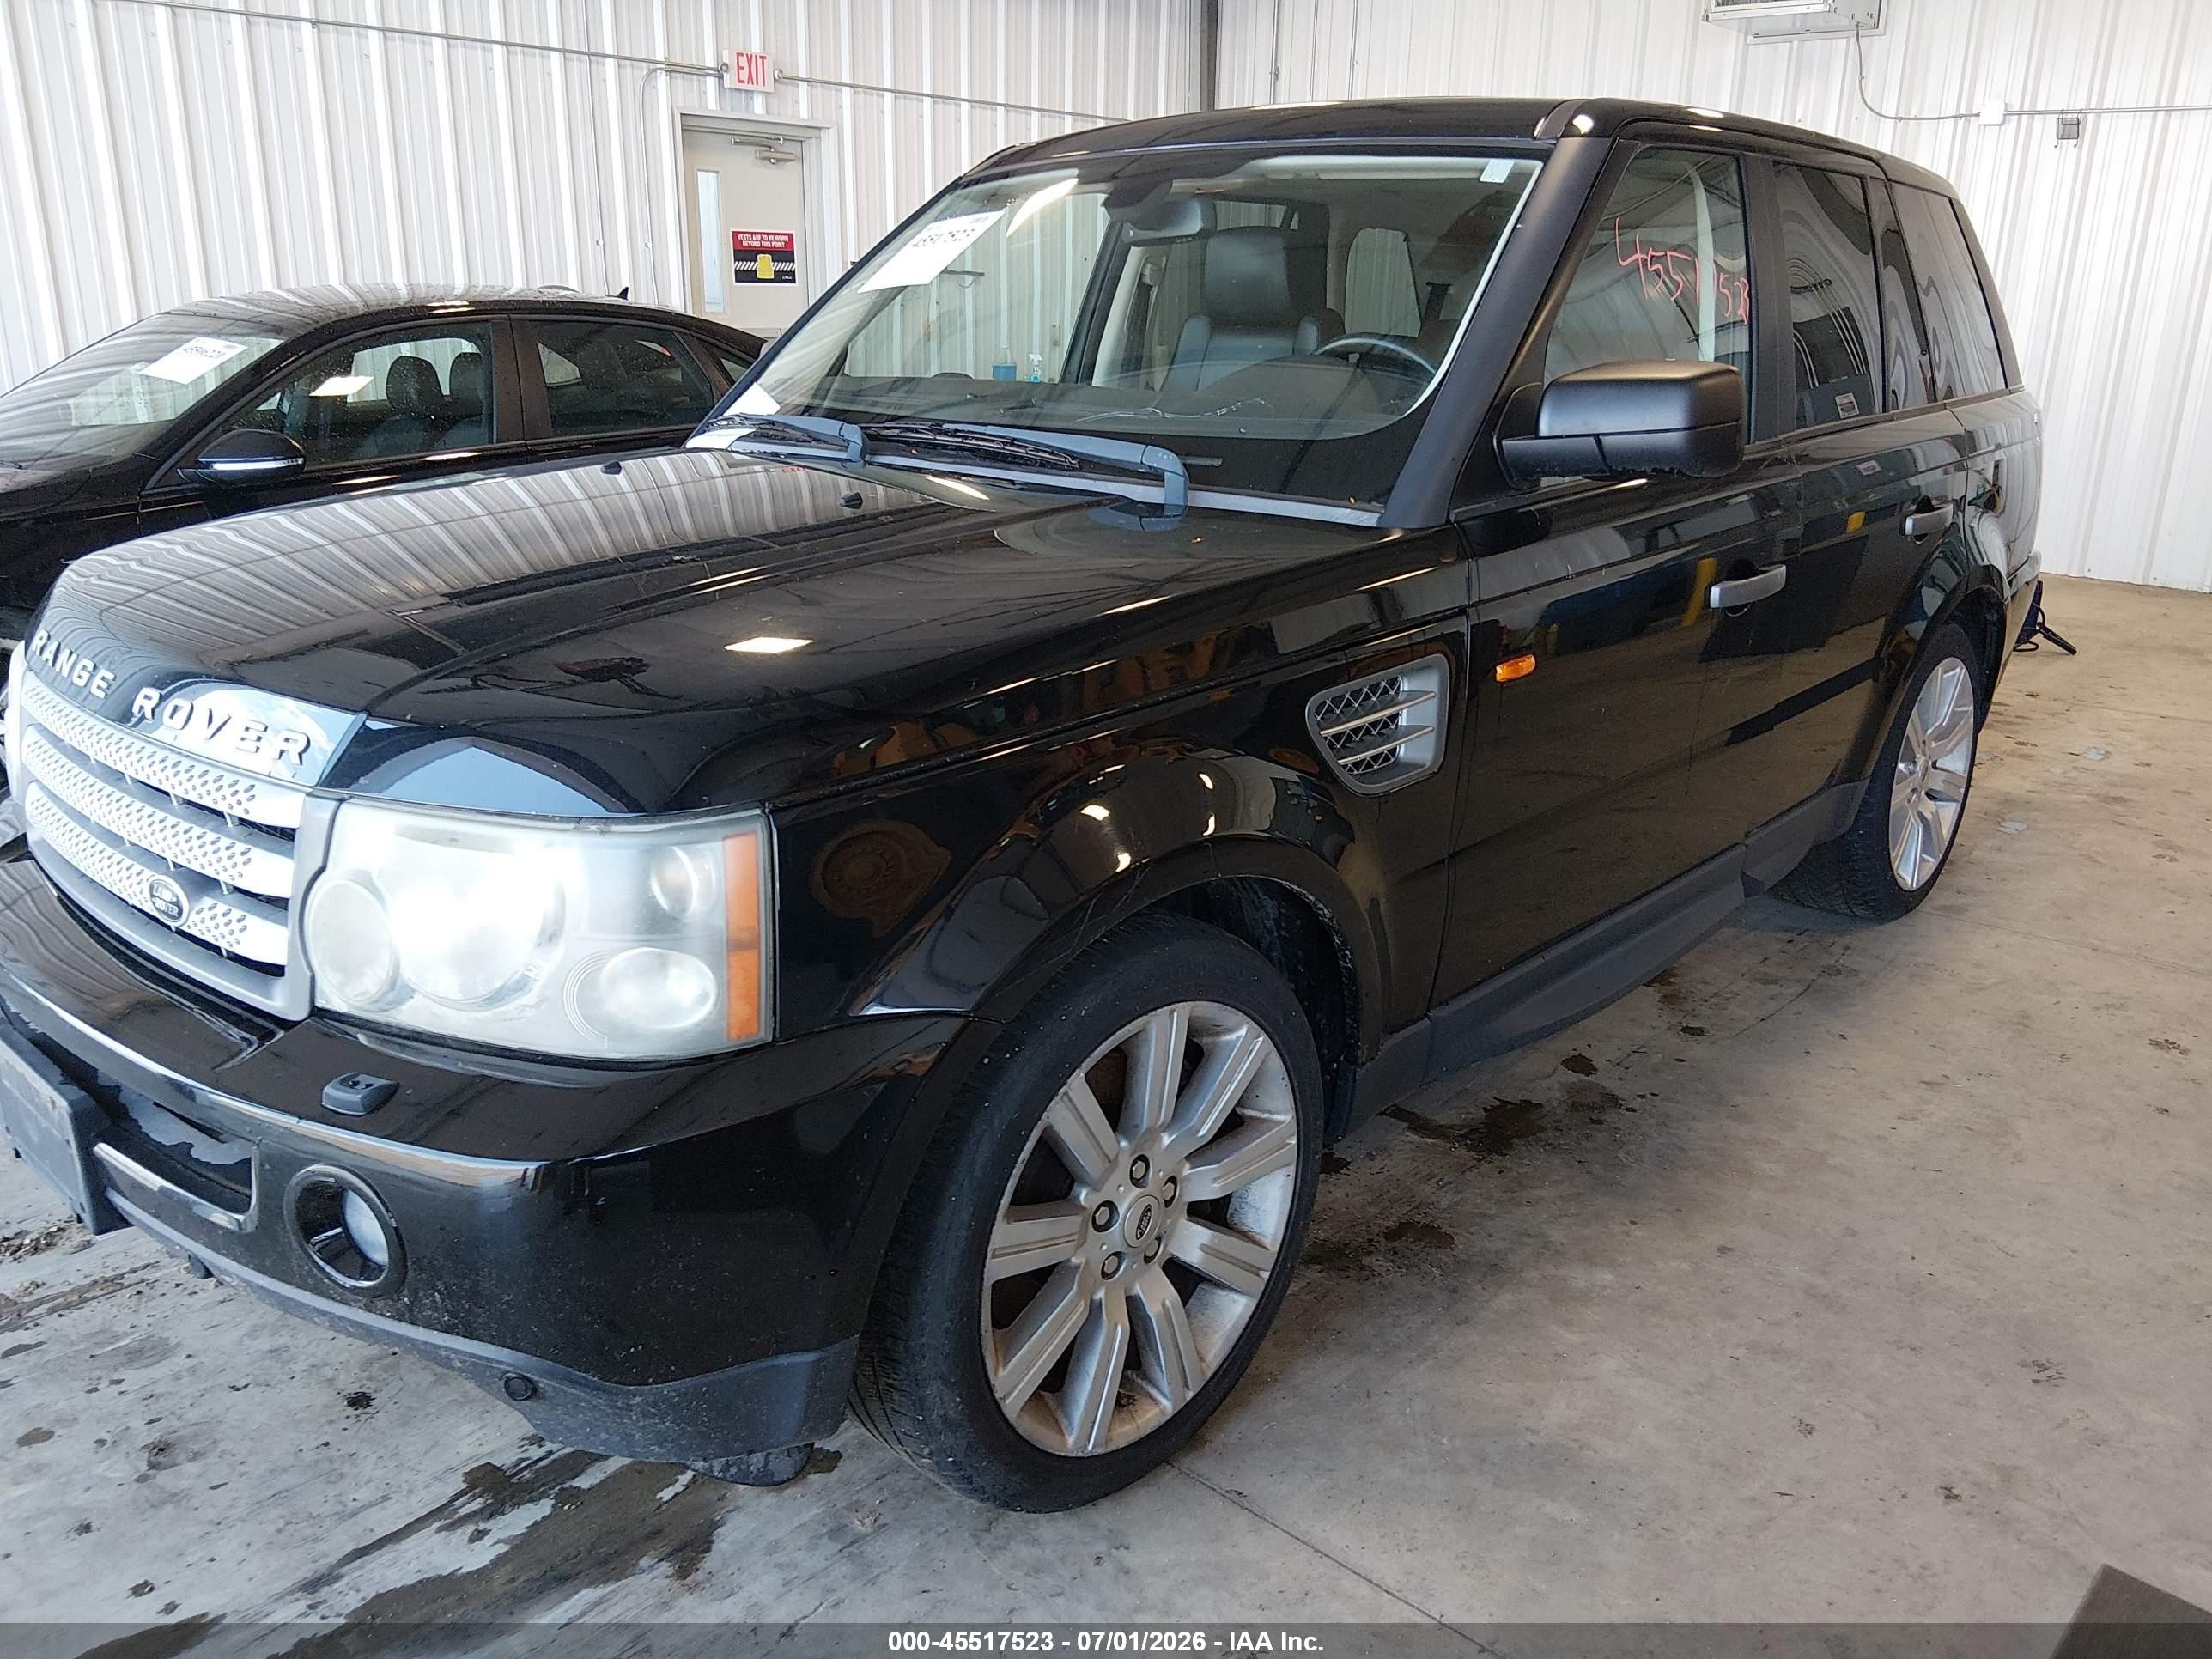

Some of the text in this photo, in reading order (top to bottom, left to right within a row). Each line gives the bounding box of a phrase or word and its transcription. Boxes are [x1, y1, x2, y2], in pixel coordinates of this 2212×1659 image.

[736, 52, 767, 87] EXIT
[33, 629, 311, 765] RANGE ROVER
